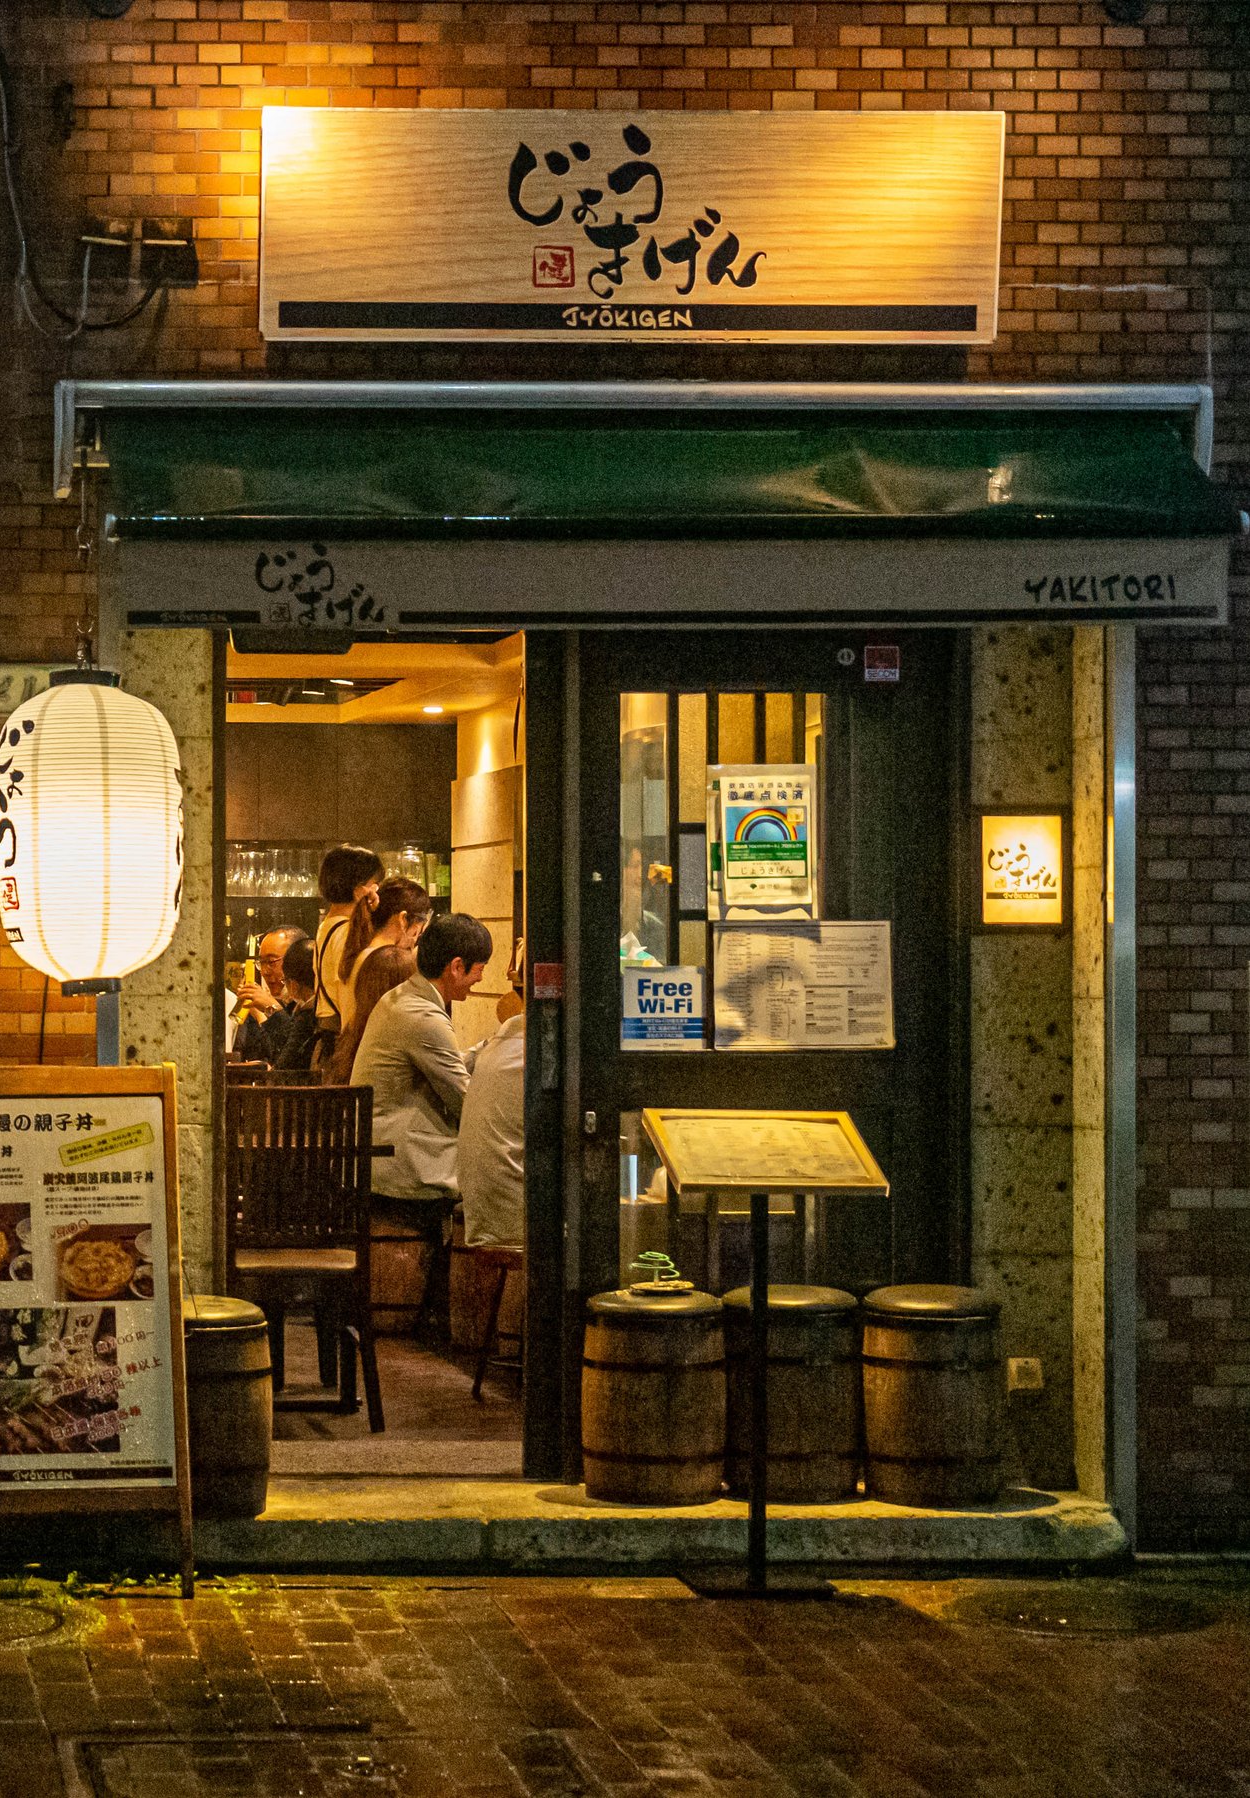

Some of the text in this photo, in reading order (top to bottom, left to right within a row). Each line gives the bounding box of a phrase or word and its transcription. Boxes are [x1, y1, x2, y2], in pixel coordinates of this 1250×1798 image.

[1024, 574, 1176, 603] YAKITORI
[637, 978, 693, 997] Free
[637, 998, 693, 1014] Wi-Fi
